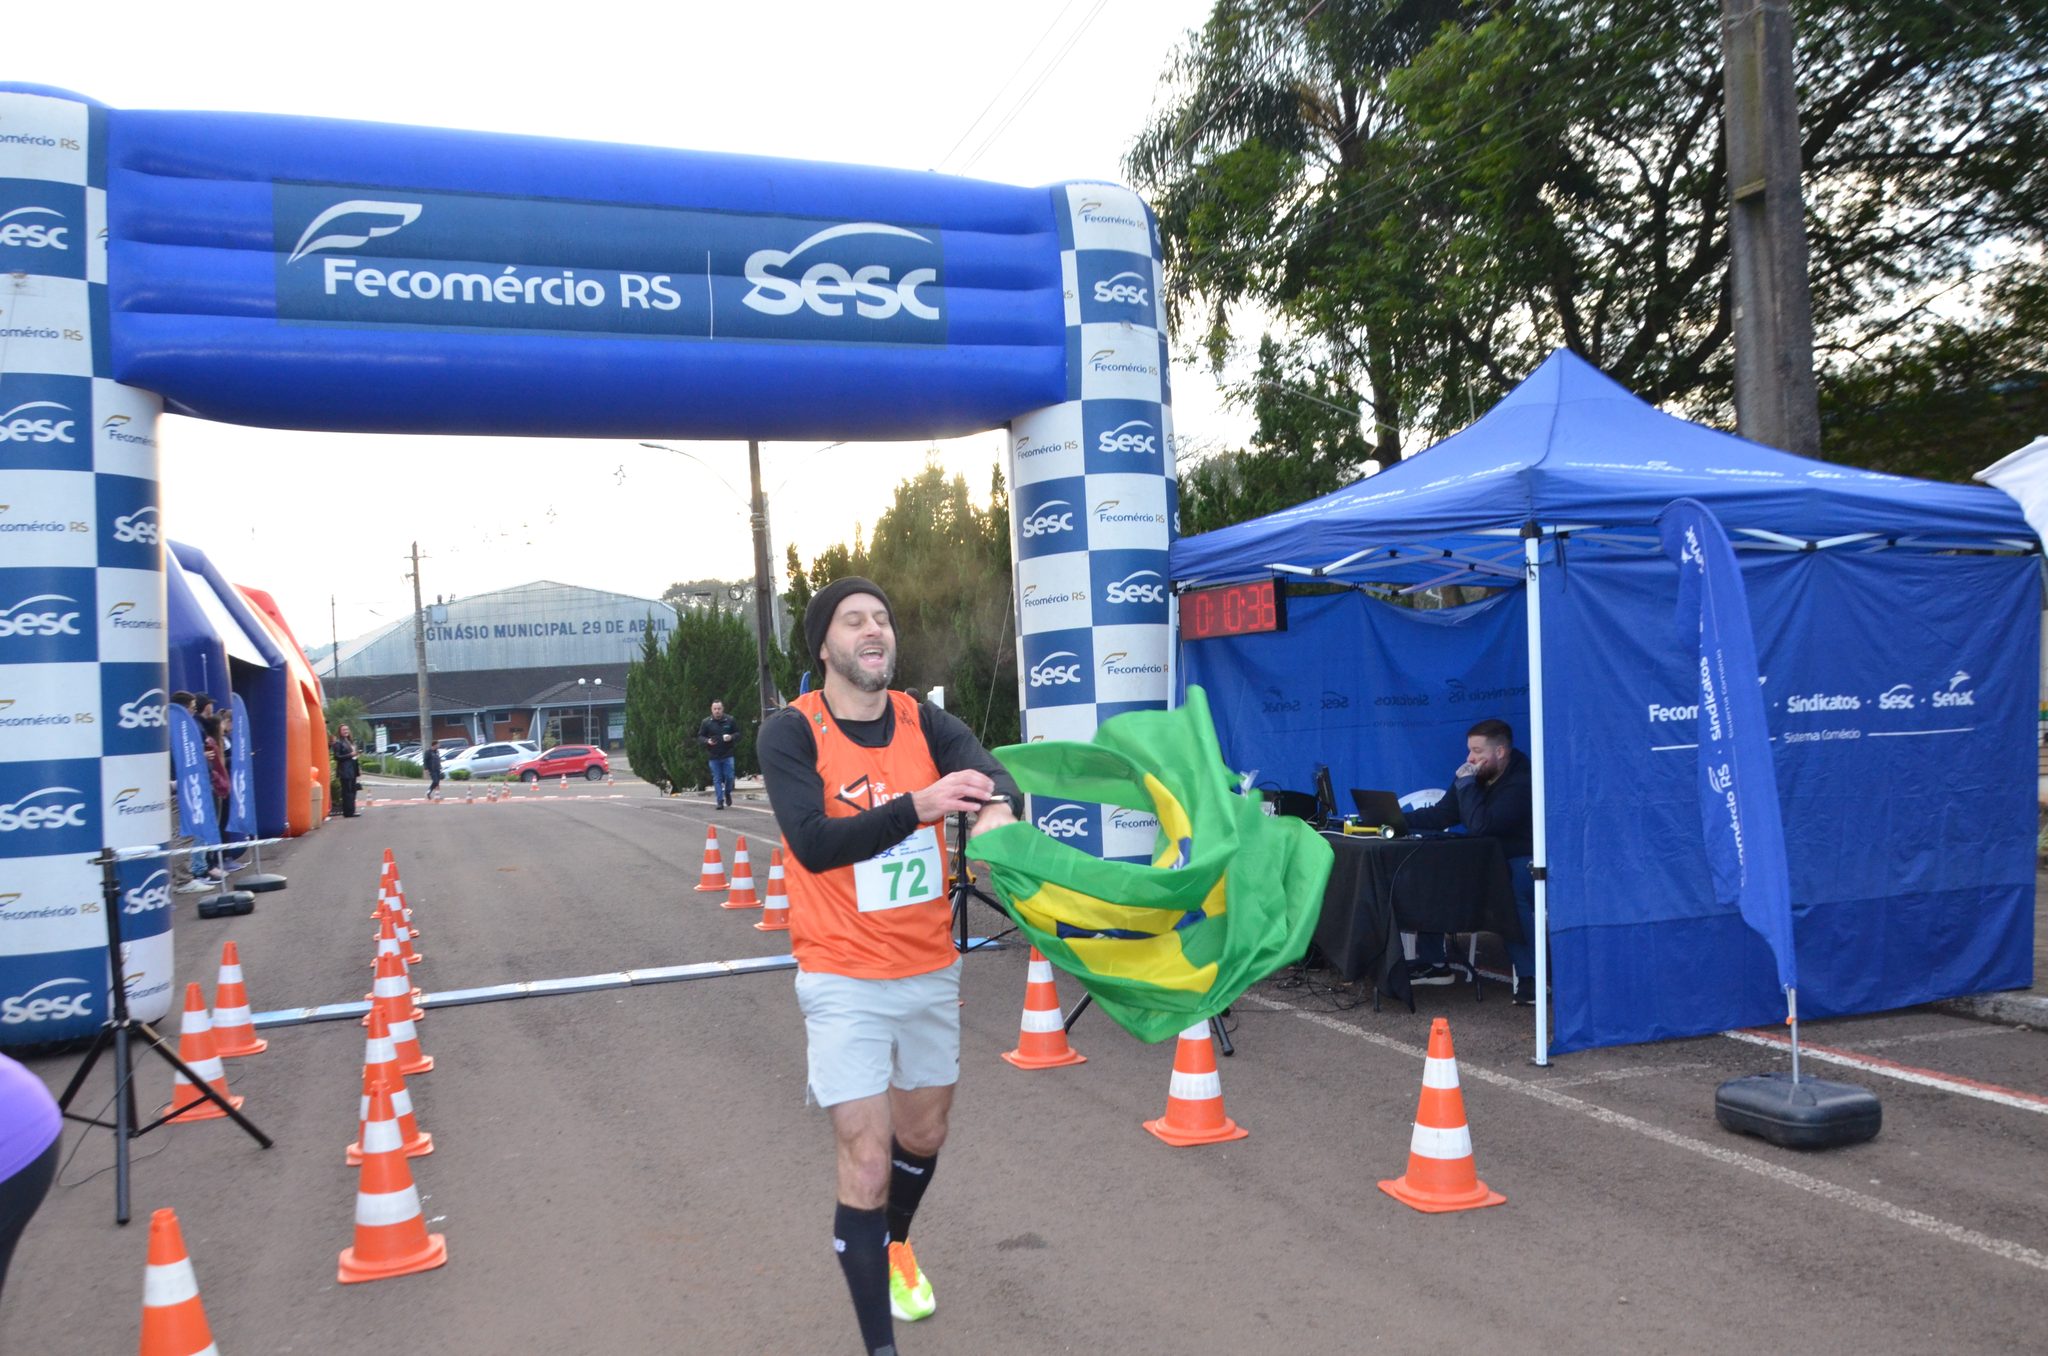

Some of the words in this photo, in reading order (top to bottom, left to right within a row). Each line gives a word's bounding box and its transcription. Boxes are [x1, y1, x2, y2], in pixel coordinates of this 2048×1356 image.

[0, 132, 56, 147] omércio
[60, 138, 80, 151] RS
[1084, 212, 1136, 228] Fecomércio
[742, 221, 941, 321] Sesc
[323, 257, 605, 309] Fecomércio
[620, 272, 682, 312] RS
[1094, 271, 1148, 307] Sesc
[0, 327, 59, 340] omércio
[63, 328, 84, 341] RS
[1094, 362, 1148, 375] Fecomércio
[1099, 420, 1155, 454] Sesc
[1017, 443, 1062, 460] Fecomércio
[1065, 440, 1078, 451] RS
[0, 520, 66, 533] comércio
[69, 521, 90, 533] RS
[1022, 500, 1074, 539] Sesc
[1099, 511, 1154, 525] Fecomércio
[1106, 570, 1164, 604] Sesc
[1024, 594, 1070, 608] Fecomércio
[1071, 591, 1086, 602] RS
[426, 623, 489, 641] GINÁSIO
[494, 622, 577, 638] MUNICIPAL
[582, 620, 601, 635] 29
[605, 620, 624, 633] DE
[1030, 651, 1081, 687] Sesc
[1107, 662, 1161, 675] Fecomércio
[1700, 656, 1721, 741] Sindicatos
[1787, 694, 1861, 714] Sindicatos
[1879, 684, 1915, 710] Sesc
[1932, 690, 1975, 708] Senac
[0, 713, 71, 727] ecomércio
[75, 712, 94, 724] RS
[1784, 732, 1820, 744] Sistema
[1821, 729, 1861, 741] Comércio
[1717, 763, 1732, 788] RS
[0, 787, 86, 831] Sesc
[1037, 804, 1089, 838] Sesc
[1115, 819, 1160, 830] Fecomér
[882, 857, 929, 901] 72
[80, 902, 100, 915] RS
[1, 977, 93, 1024] Sesc
